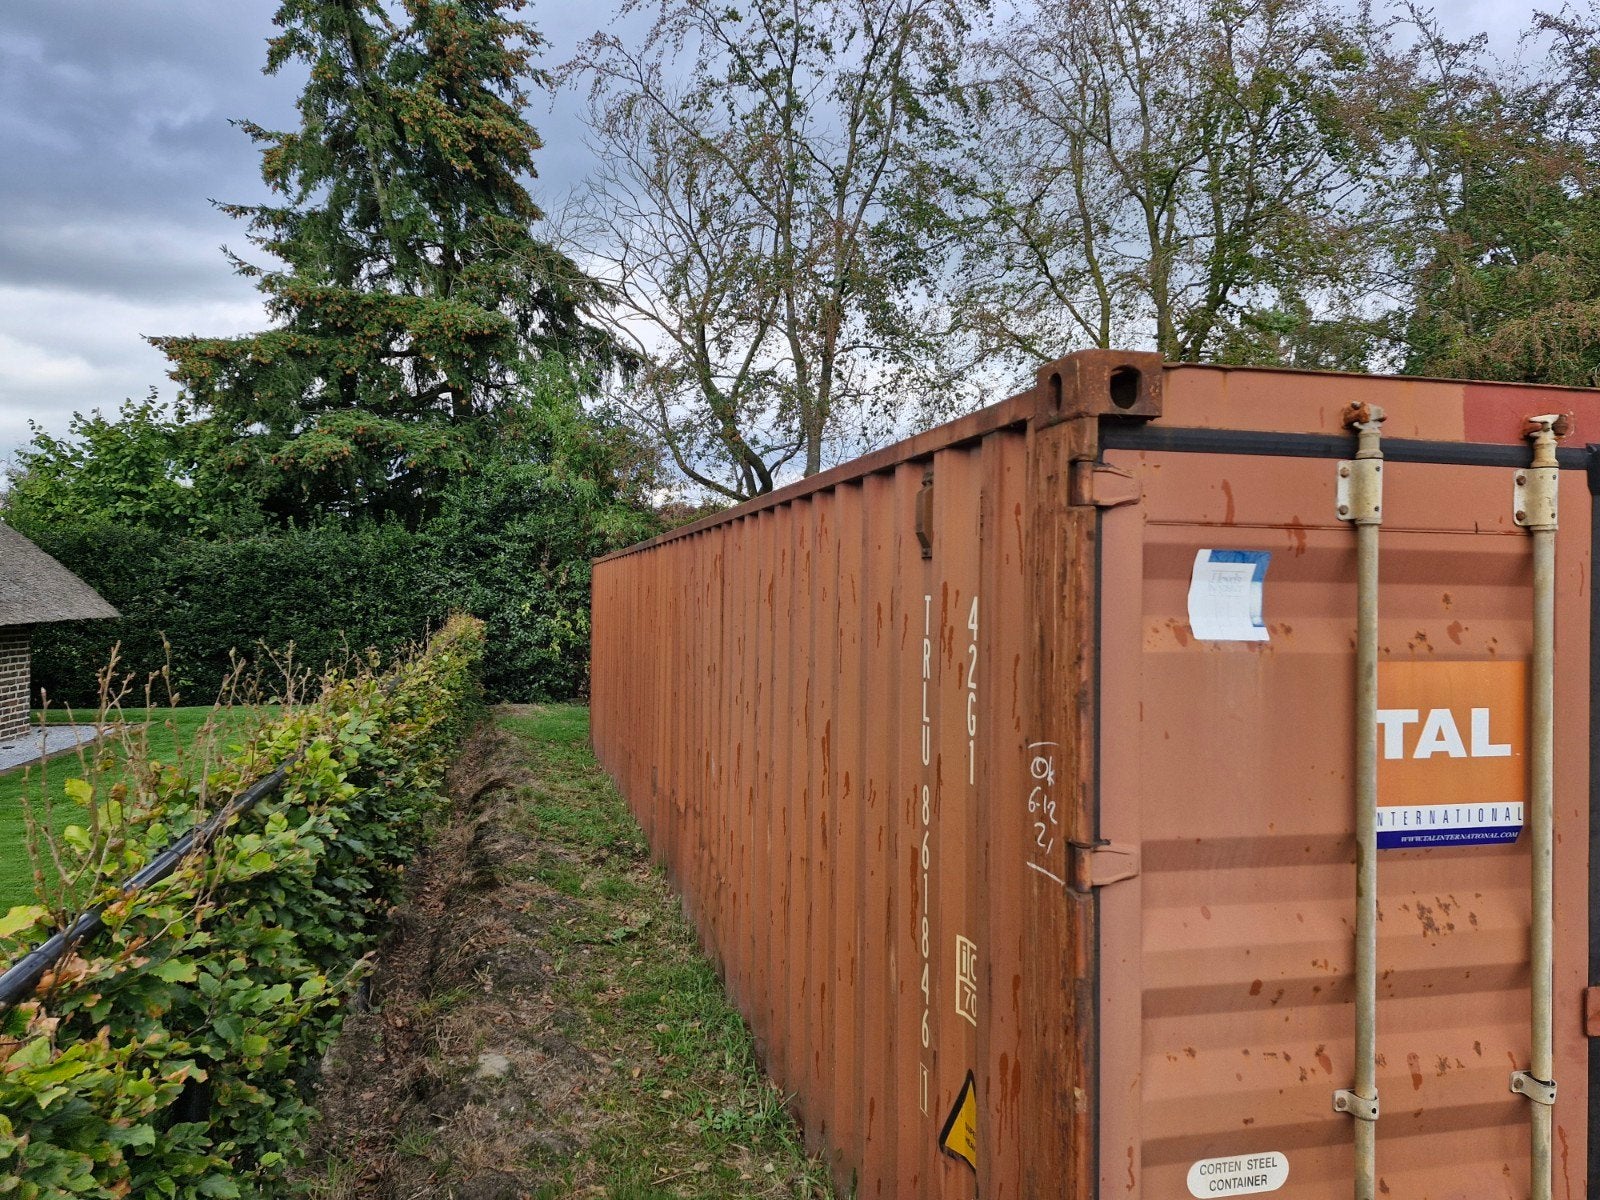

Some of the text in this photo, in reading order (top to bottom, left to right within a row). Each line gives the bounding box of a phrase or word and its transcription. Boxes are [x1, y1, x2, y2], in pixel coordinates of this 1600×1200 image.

[922, 595, 931, 766] TRLU
[967, 596, 978, 785] 42G1
[1376, 707, 1512, 760] TAL
[1377, 806, 1523, 827] NTERNATIONAL
[921, 785, 930, 1048] 861846
[1199, 1156, 1278, 1176] CORTEN STEEL
[1209, 1174, 1268, 1192] CONTAINER
